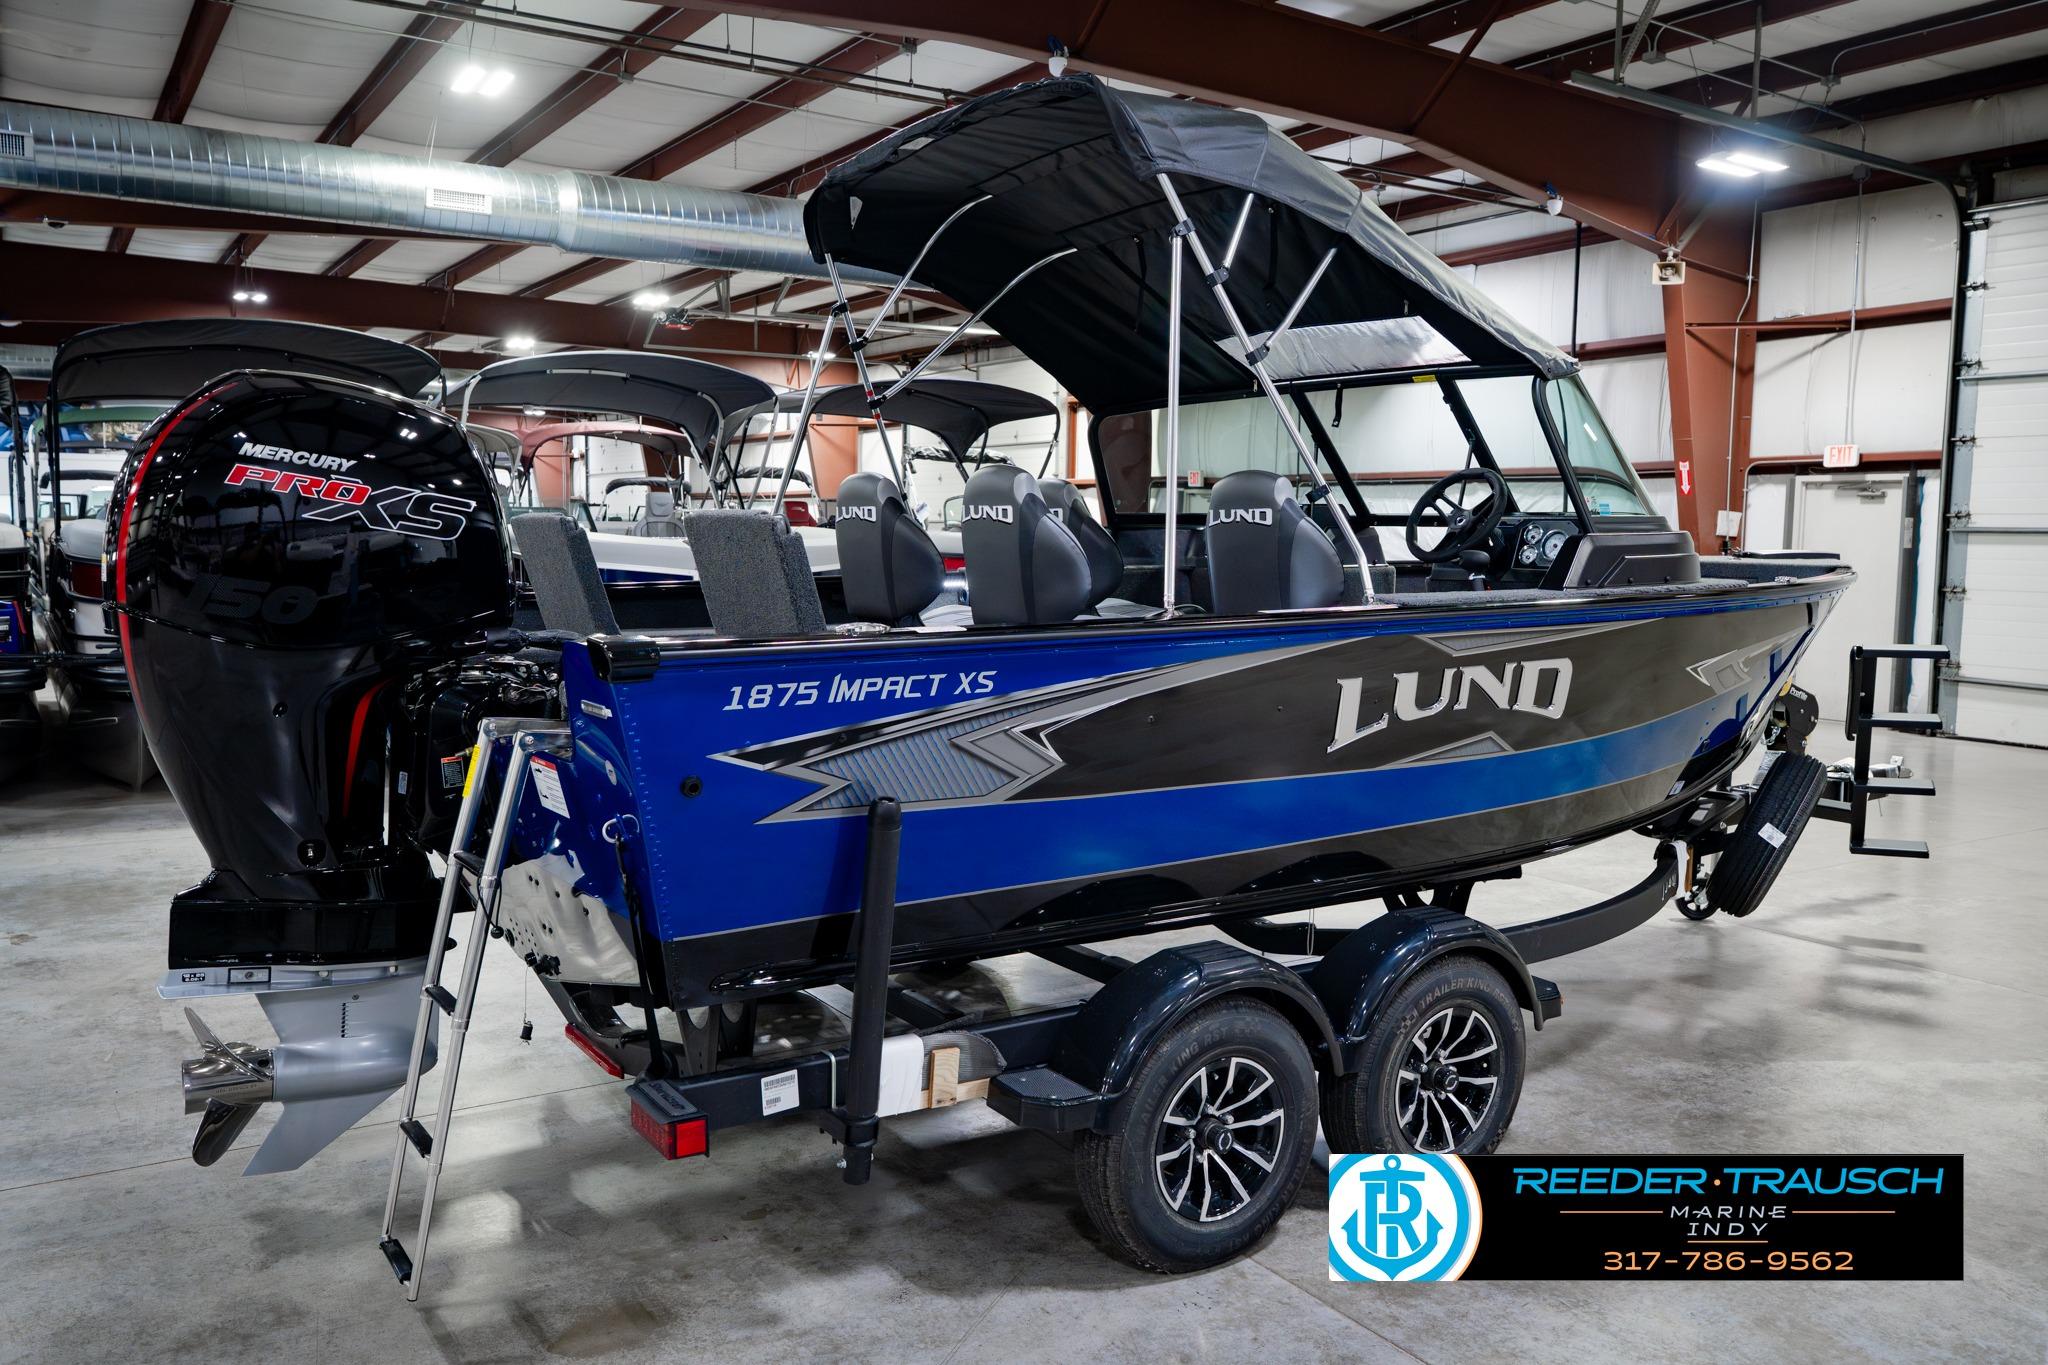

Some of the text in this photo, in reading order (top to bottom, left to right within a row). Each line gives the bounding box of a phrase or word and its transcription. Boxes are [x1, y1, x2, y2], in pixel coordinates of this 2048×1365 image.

[239, 442, 358, 473] MERCURY
[1829, 446, 1854, 465] EXIT
[224, 463, 372, 506] PRO
[836, 505, 877, 522] LUND
[962, 504, 1014, 524] LUND
[1208, 507, 1273, 527] LUND
[722, 670, 998, 711] 1875 IMPACT XS
[1327, 657, 1573, 754] LUND
